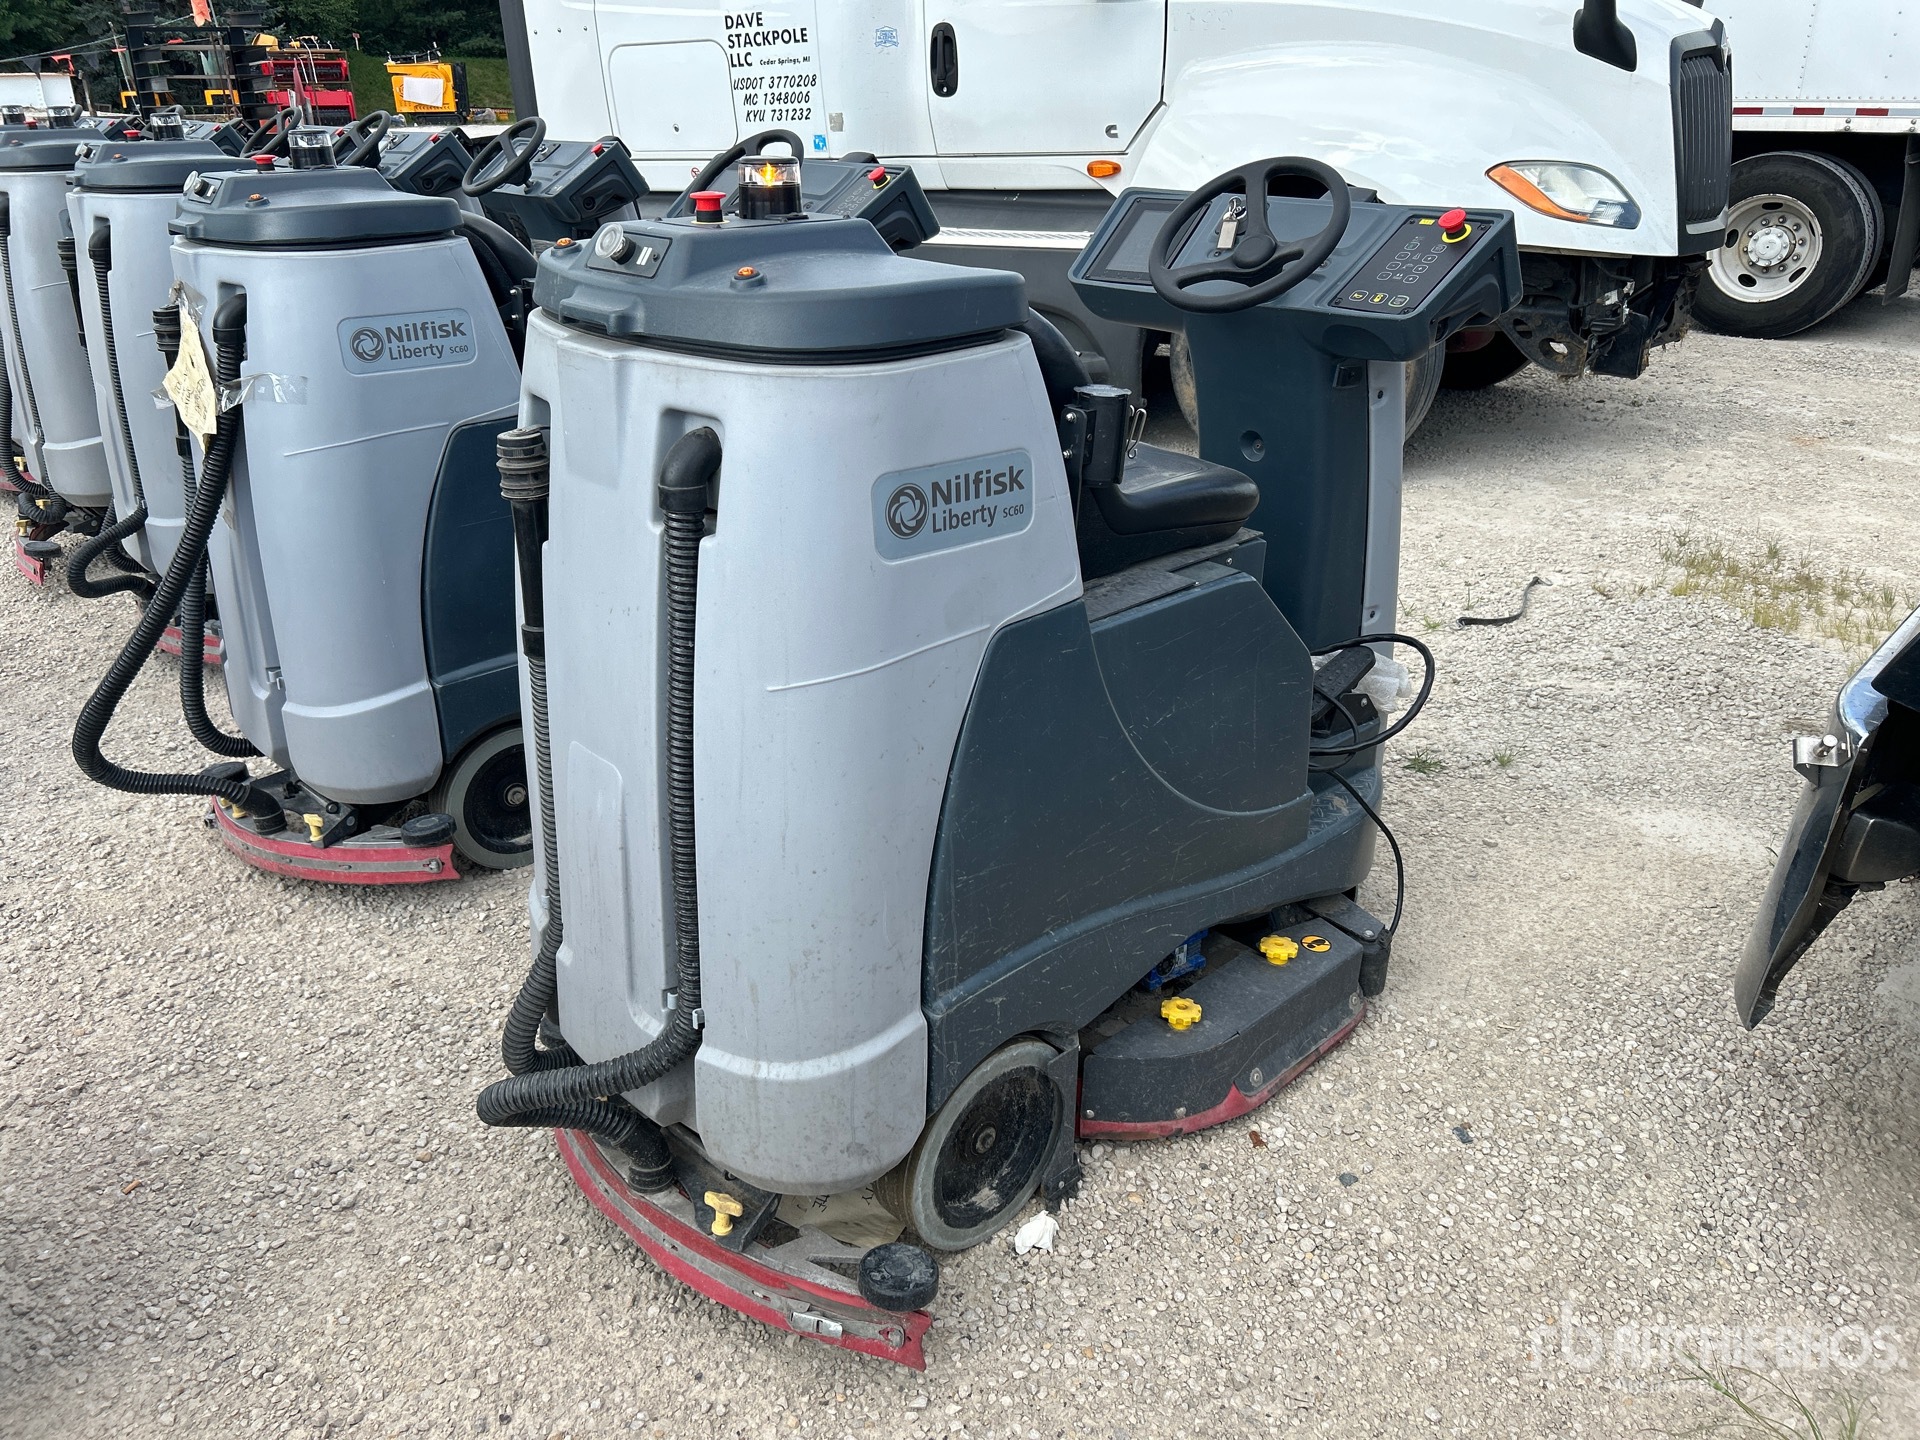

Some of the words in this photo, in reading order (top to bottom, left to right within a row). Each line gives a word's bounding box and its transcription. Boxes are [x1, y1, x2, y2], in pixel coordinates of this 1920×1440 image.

[724, 12, 764, 30] DAVE
[727, 27, 808, 49] STACKPOLE
[730, 52, 753, 68] LLC
[778, 57, 801, 66] Springs,
[733, 76, 765, 91] USDOT
[768, 73, 817, 89] 3770208
[743, 93, 759, 106] MC
[763, 90, 811, 106] 1348006
[745, 109, 766, 123] KYU
[770, 107, 812, 122] 731232
[384, 319, 467, 344] Nilfisk
[388, 344, 445, 361] Liberty
[449, 344, 469, 354] SC60
[931, 465, 1025, 508] Nilfisk
[932, 504, 998, 534] Liberty
[1003, 503, 1025, 519] SC60
